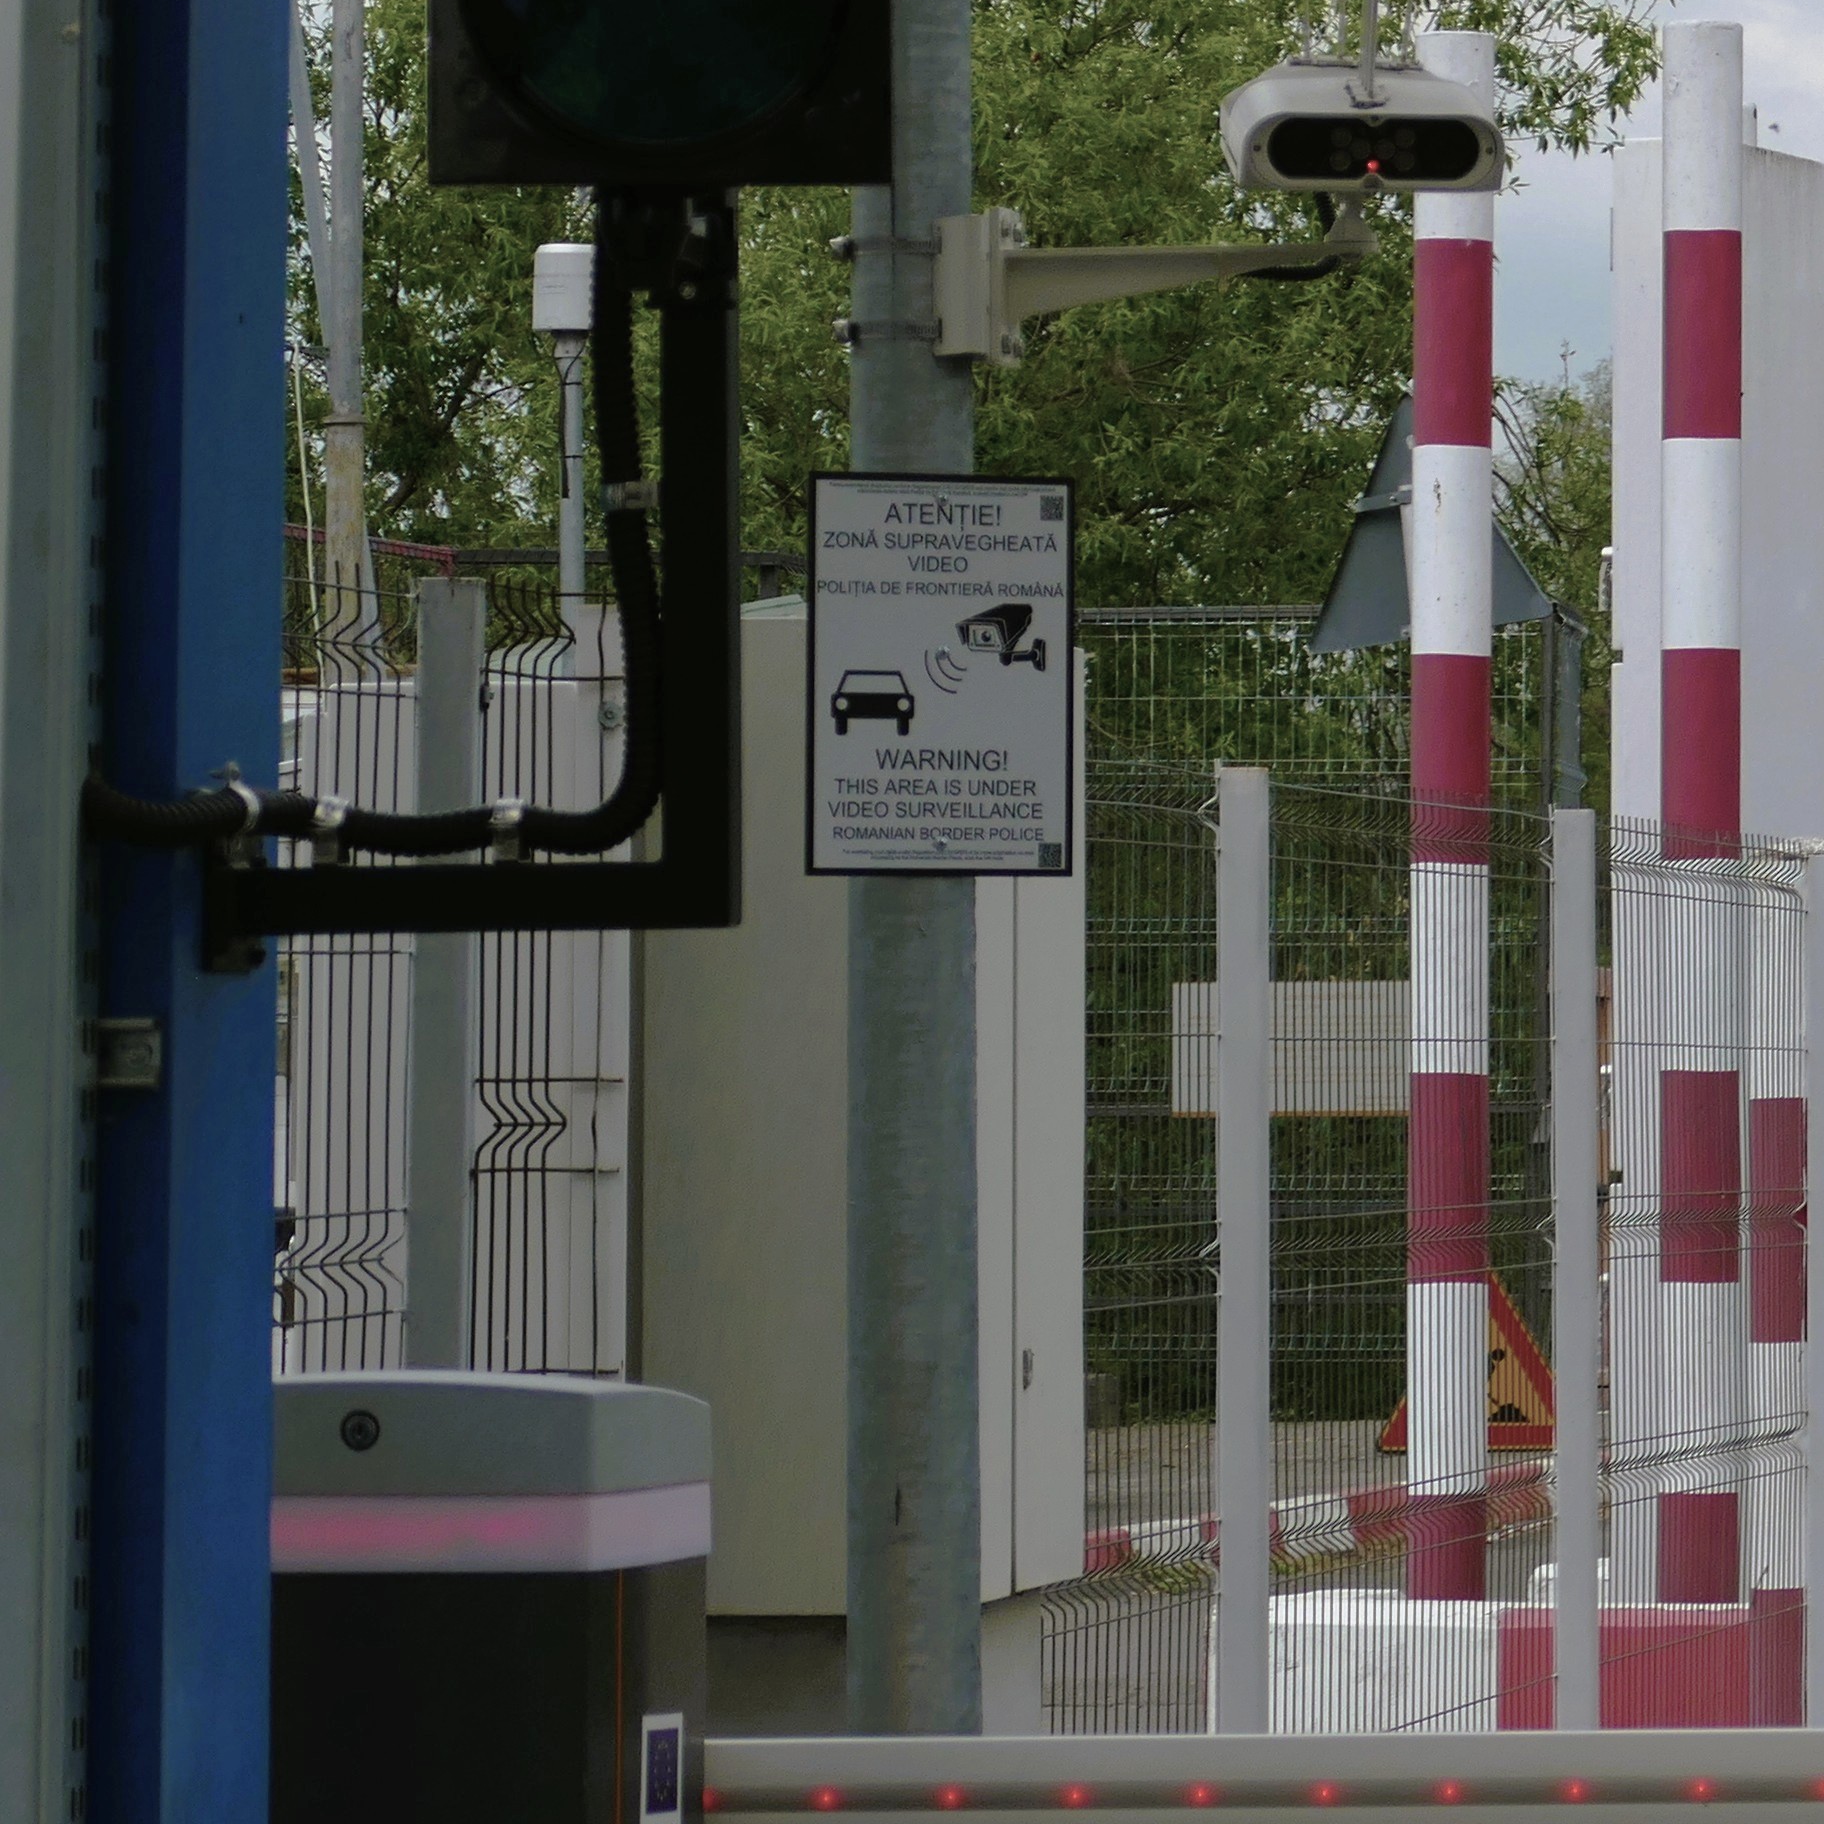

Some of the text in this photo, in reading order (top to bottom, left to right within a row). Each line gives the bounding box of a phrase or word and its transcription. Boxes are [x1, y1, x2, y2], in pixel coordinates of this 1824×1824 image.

[885, 502, 1001, 531] ATENȚIE!
[824, 530, 1057, 553] ZONĂ SUPRAVEGHEATĂ
[908, 556, 967, 573] VIDEO
[881, 582, 900, 594] DE
[906, 580, 993, 596] FRONTIERĂ
[999, 581, 1064, 597] ROMÂNĂ
[876, 749, 1008, 772] WARNING!
[836, 779, 1036, 796] THIS AREA IS UNDER
[829, 802, 1043, 820] VIDEO SURVEILLANCE
[833, 827, 1044, 841] ROMANIAN BORDER POLICE
